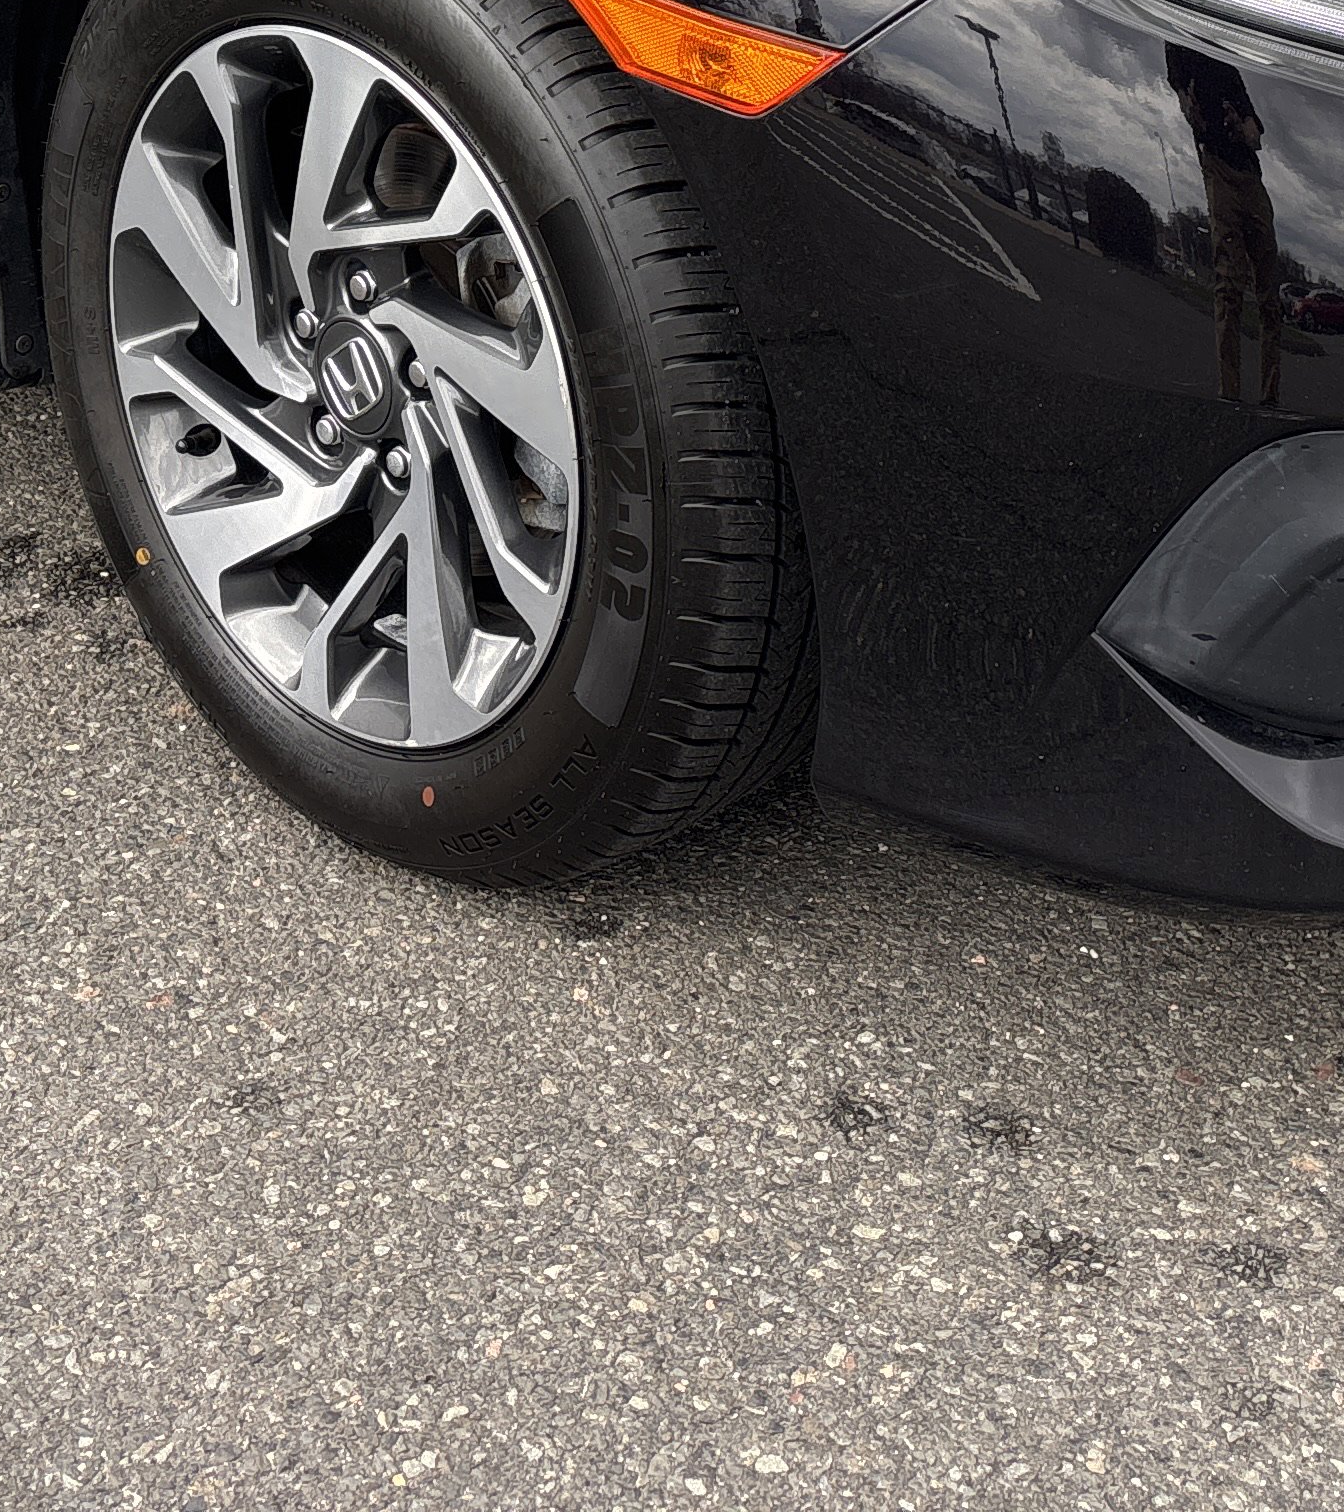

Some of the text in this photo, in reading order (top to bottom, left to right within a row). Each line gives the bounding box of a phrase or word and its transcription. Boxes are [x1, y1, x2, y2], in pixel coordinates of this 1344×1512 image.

[579, 326, 649, 622] HPZ-02
[549, 733, 599, 792] ALL
[438, 793, 554, 858] SEASON
